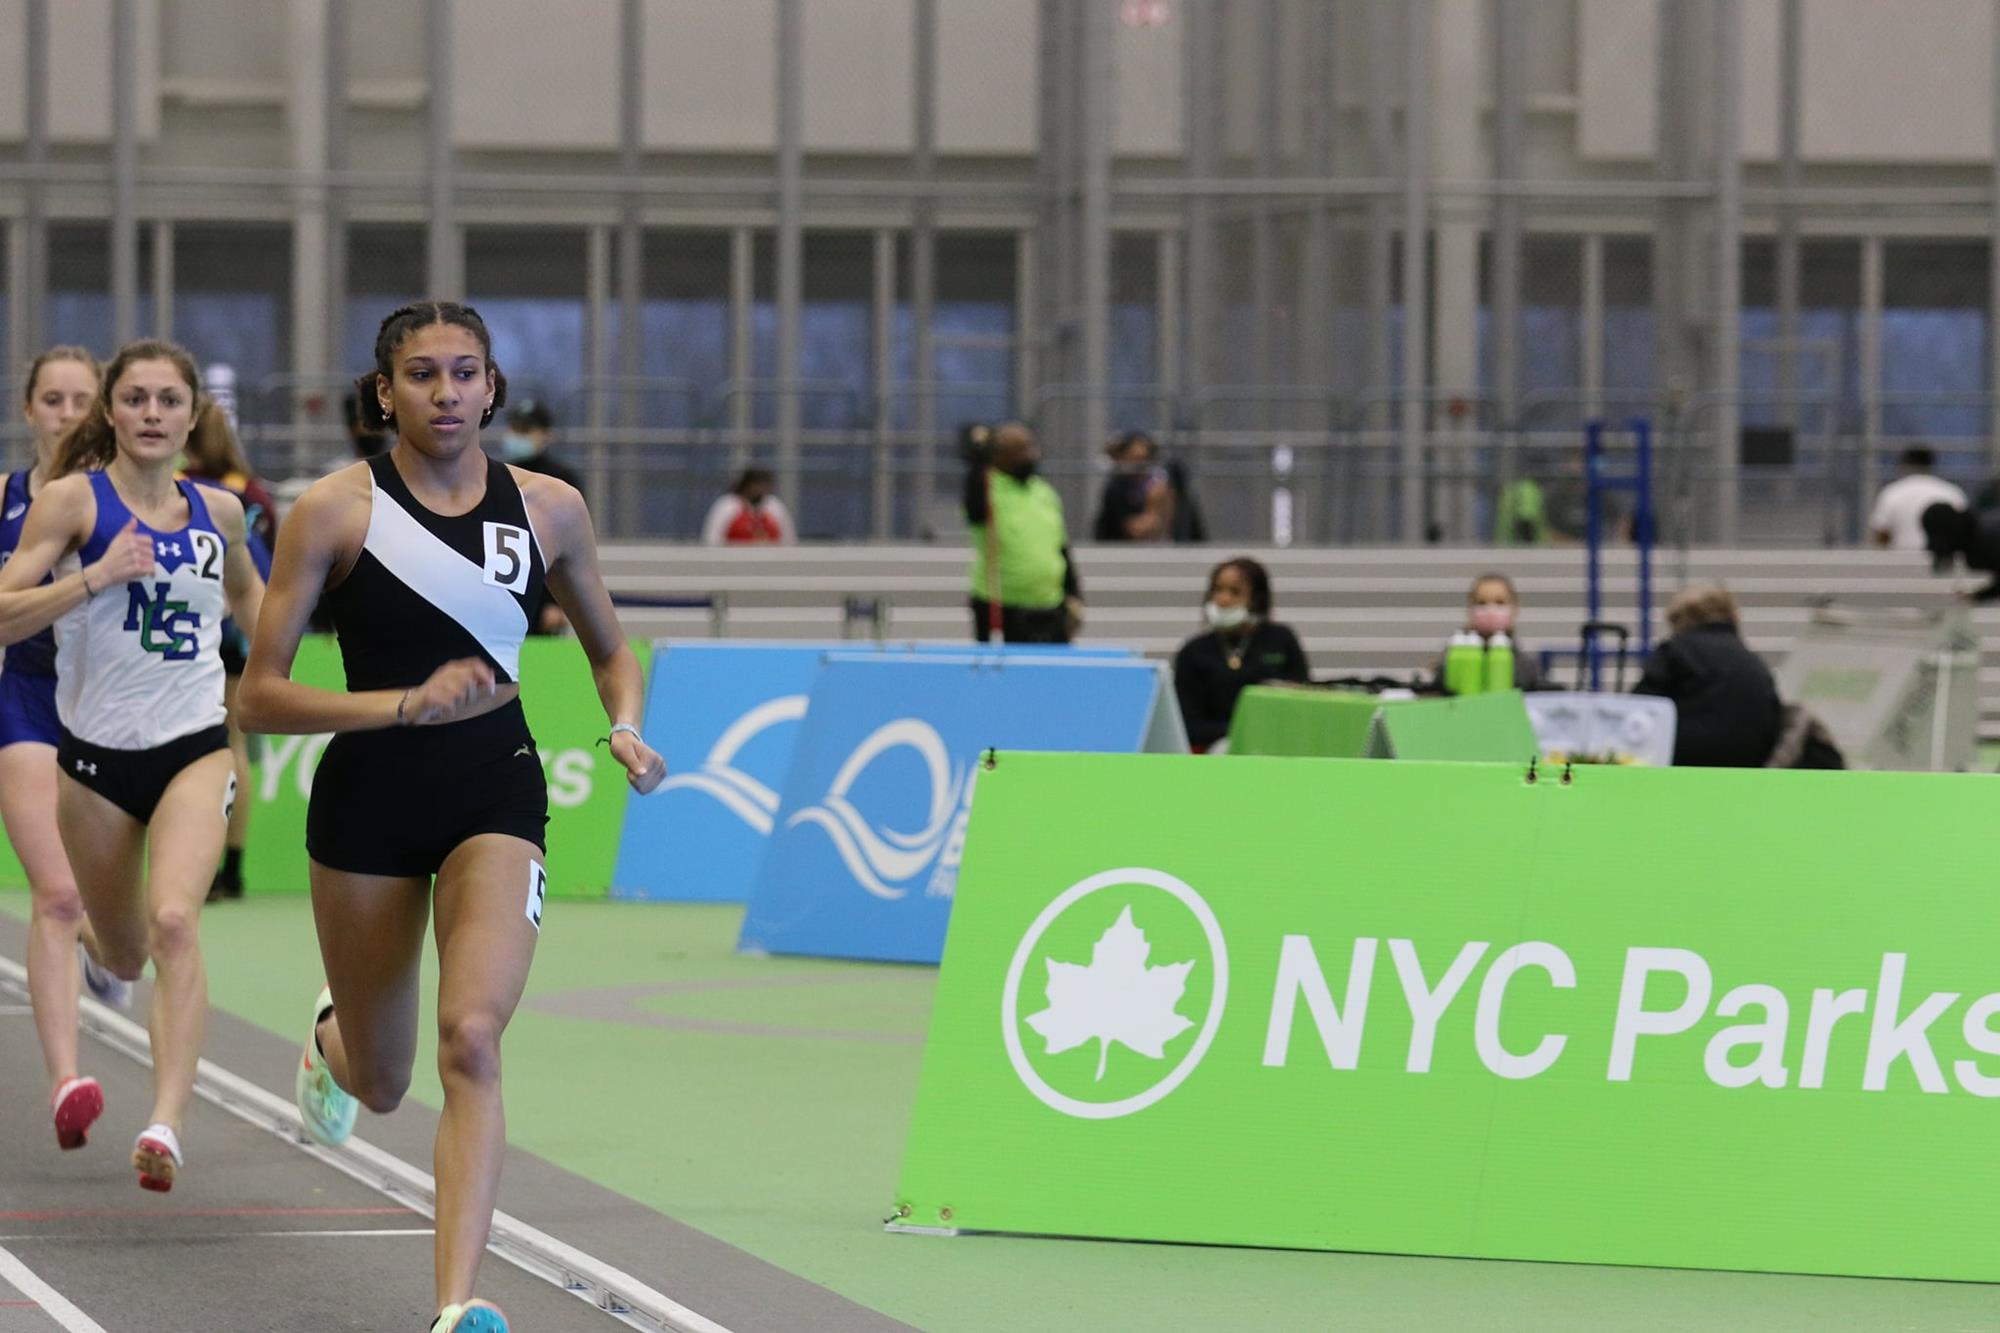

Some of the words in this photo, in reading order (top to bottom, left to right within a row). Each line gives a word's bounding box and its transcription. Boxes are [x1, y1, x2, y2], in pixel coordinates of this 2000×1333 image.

[196, 534, 220, 581] 2
[494, 526, 521, 585] 5
[1262, 934, 1577, 1080] NYC
[1606, 946, 2000, 1098] Parks
